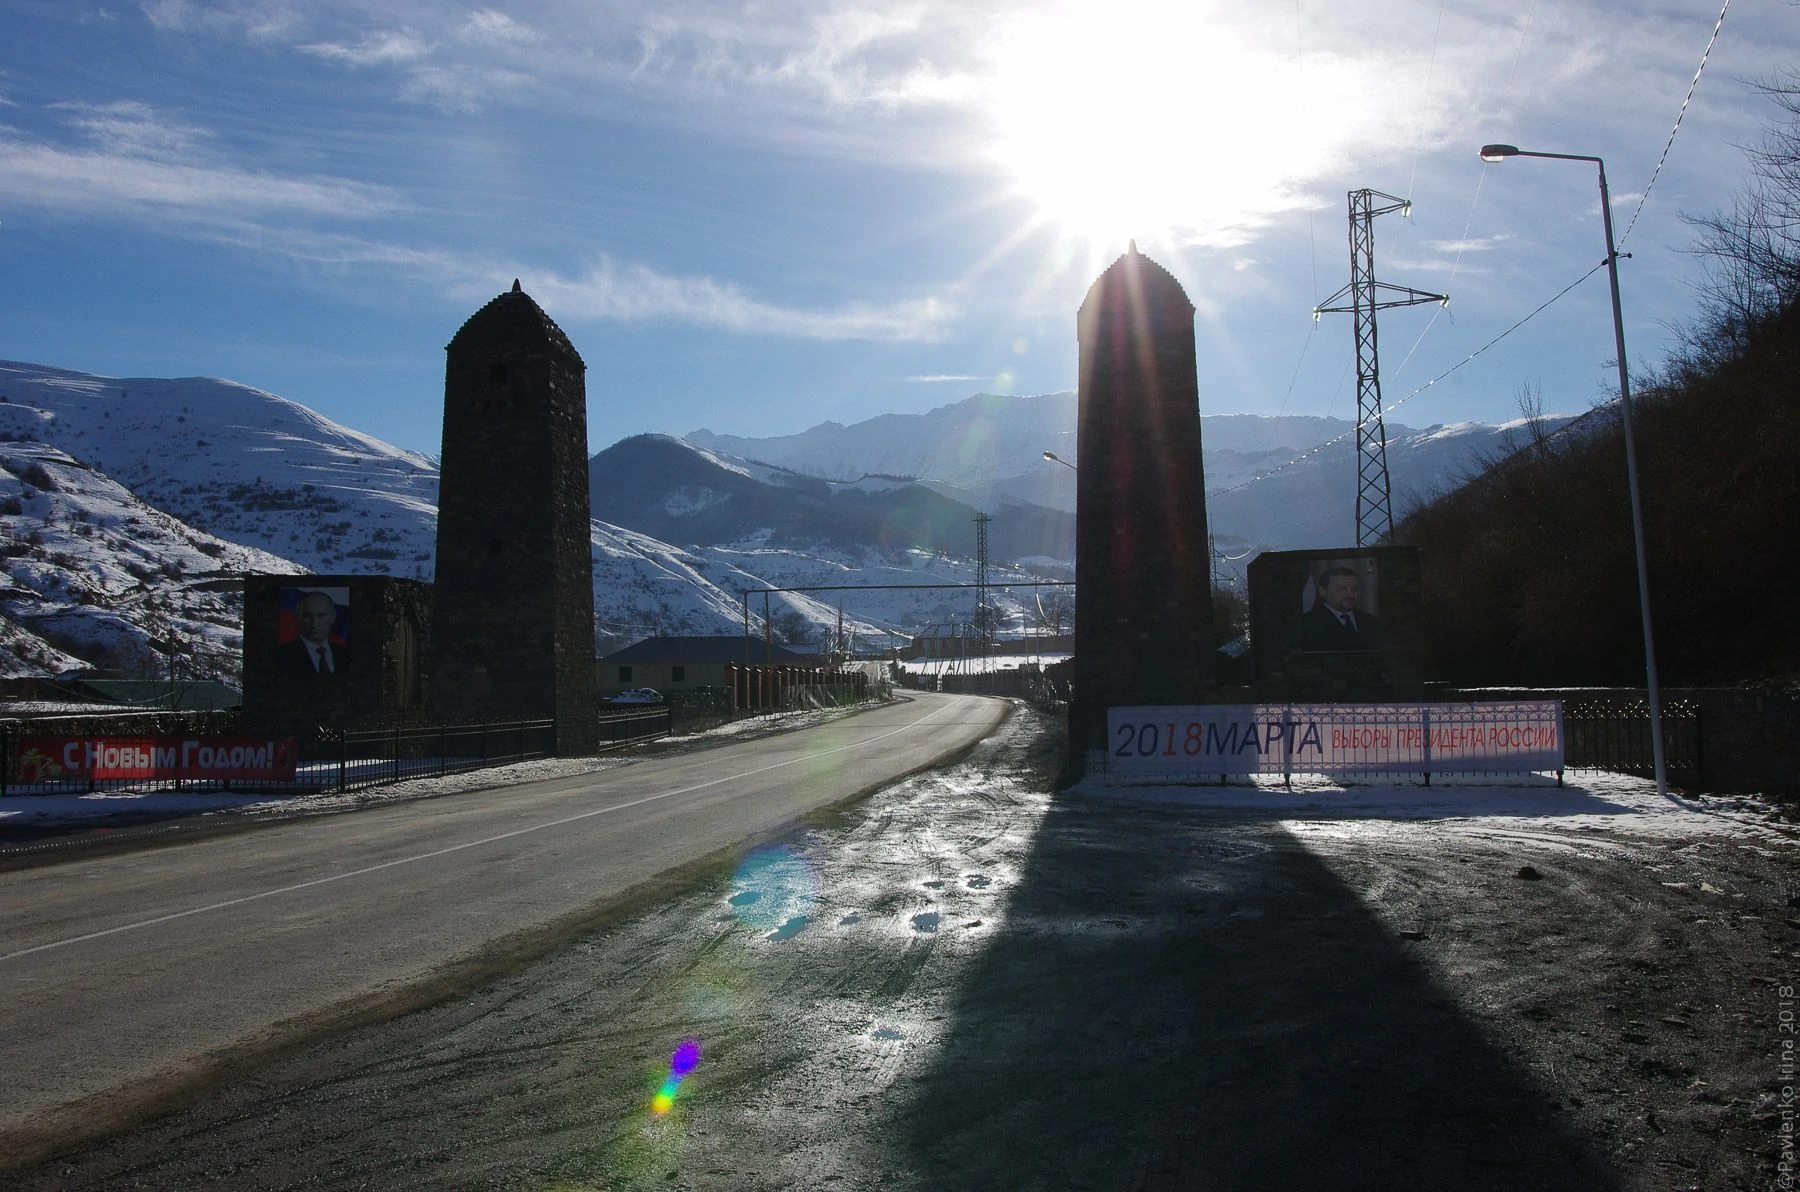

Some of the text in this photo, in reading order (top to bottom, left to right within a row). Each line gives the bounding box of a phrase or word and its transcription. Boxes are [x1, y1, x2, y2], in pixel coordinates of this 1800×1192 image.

[1332, 728, 1391, 749] ВЫБОРЫ
[1397, 727, 1484, 751] ПРЕЗИДЕНТА
[1488, 726, 1557, 748] РОССИИ
[63, 741, 274, 769] С Новым Годом!
